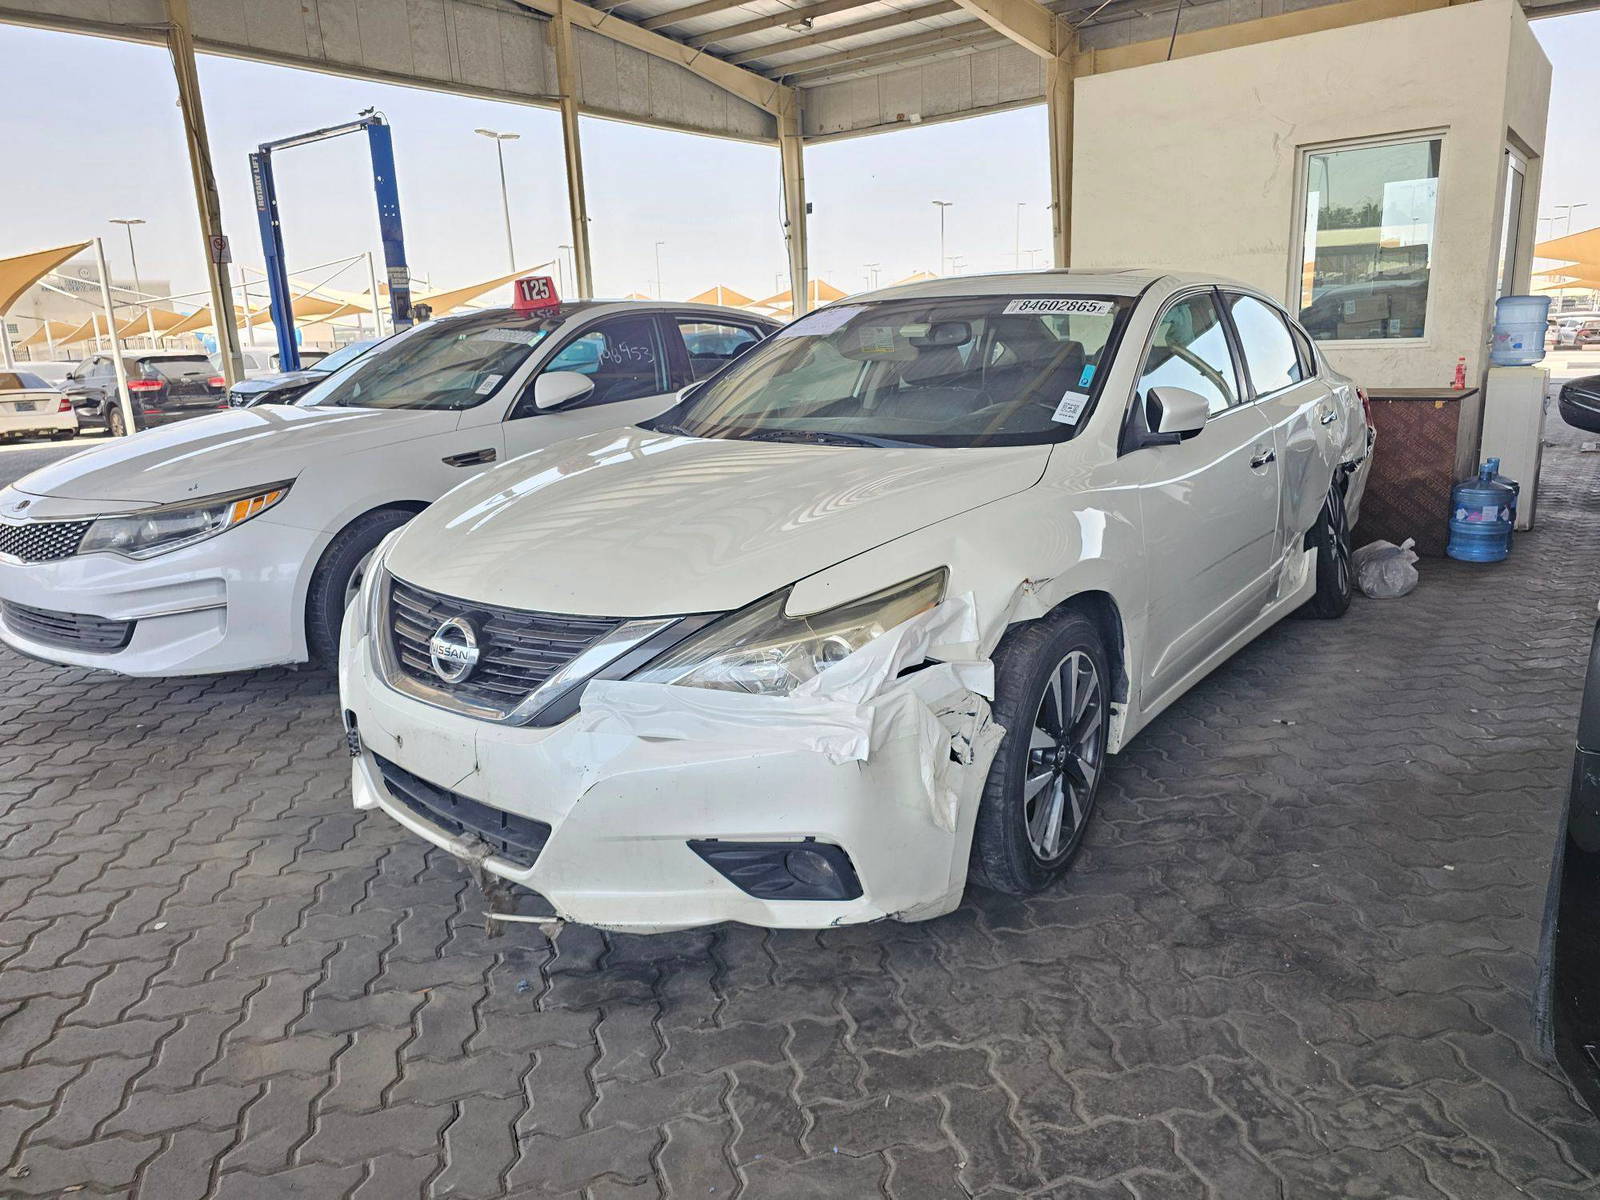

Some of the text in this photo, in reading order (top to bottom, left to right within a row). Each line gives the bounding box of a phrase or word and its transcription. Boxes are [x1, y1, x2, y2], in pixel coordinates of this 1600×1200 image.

[251, 156, 265, 208] ROTARY LIFT
[521, 279, 550, 301] 125
[1019, 300, 1099, 313] 84602865
[431, 641, 469, 660] NISSAN
